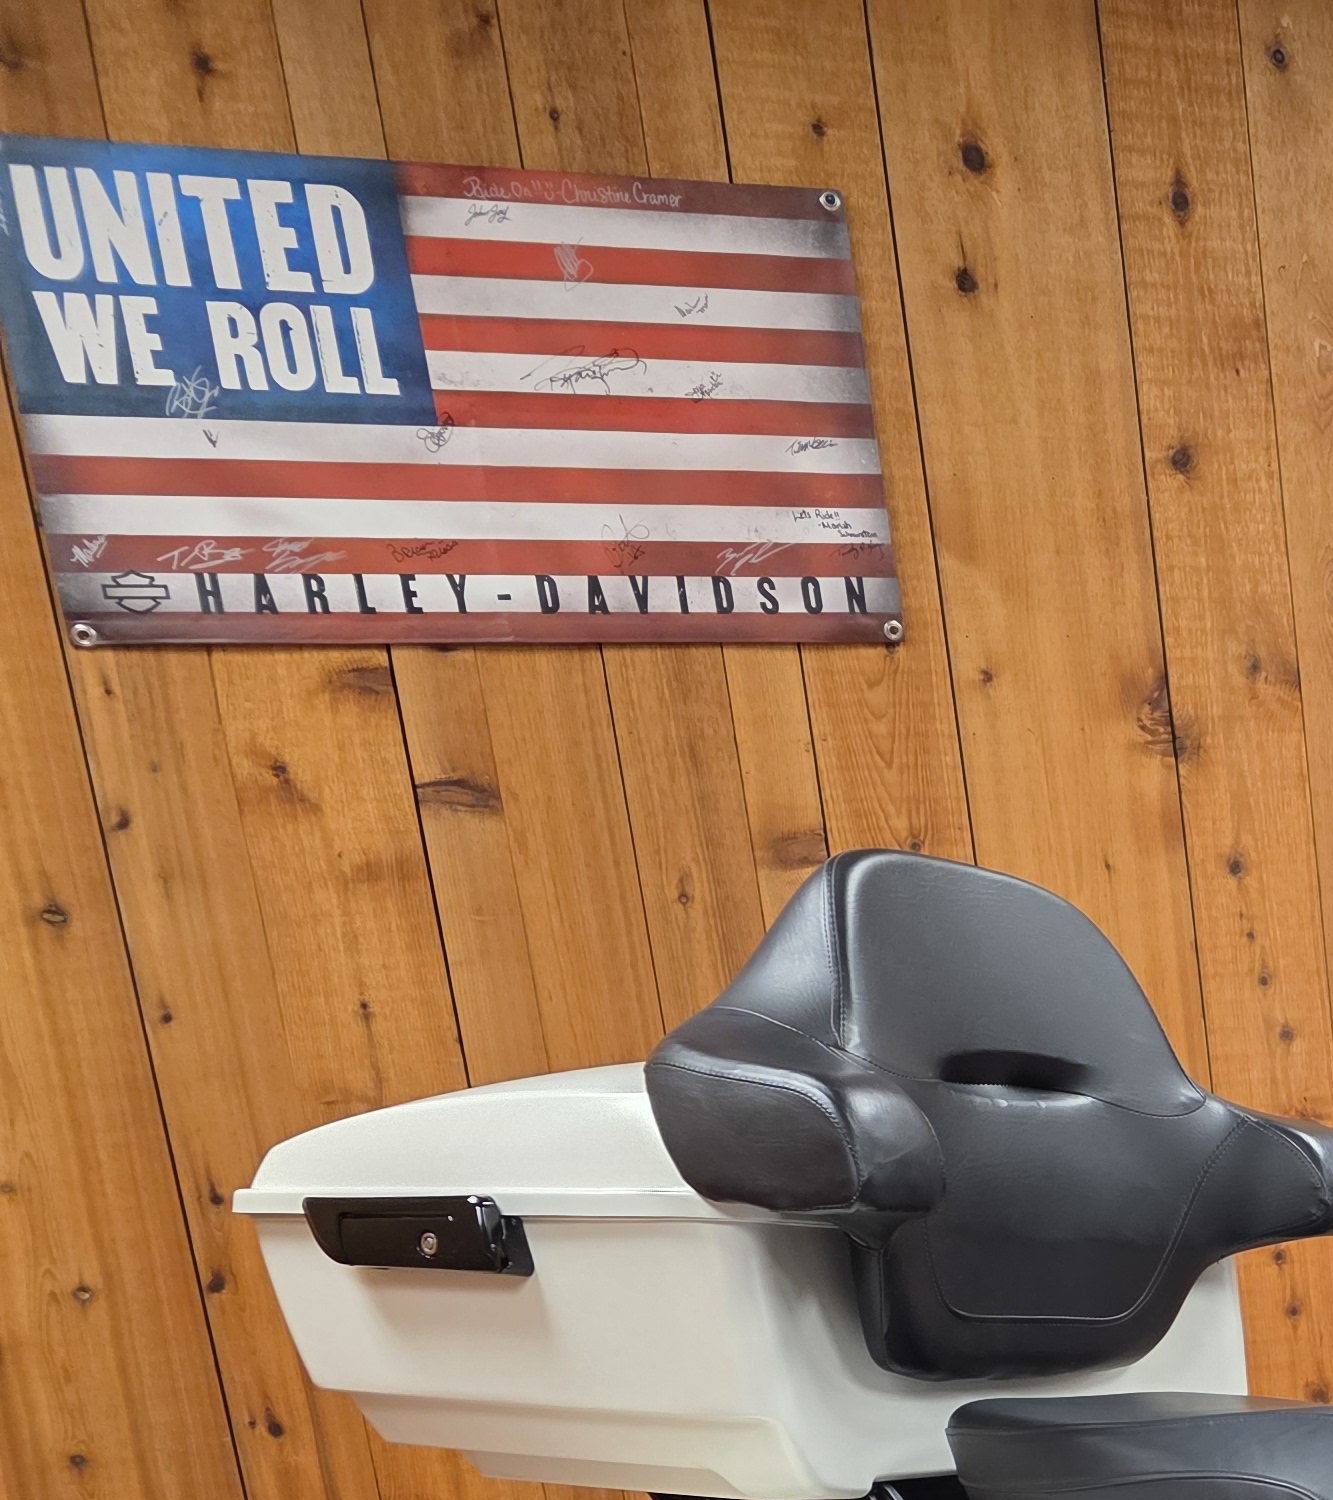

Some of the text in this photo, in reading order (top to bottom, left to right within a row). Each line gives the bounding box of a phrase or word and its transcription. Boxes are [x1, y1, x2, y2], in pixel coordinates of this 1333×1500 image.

[8, 163, 375, 295] UNITED
[32, 290, 176, 387] WE
[205, 300, 400, 396] ROLL
